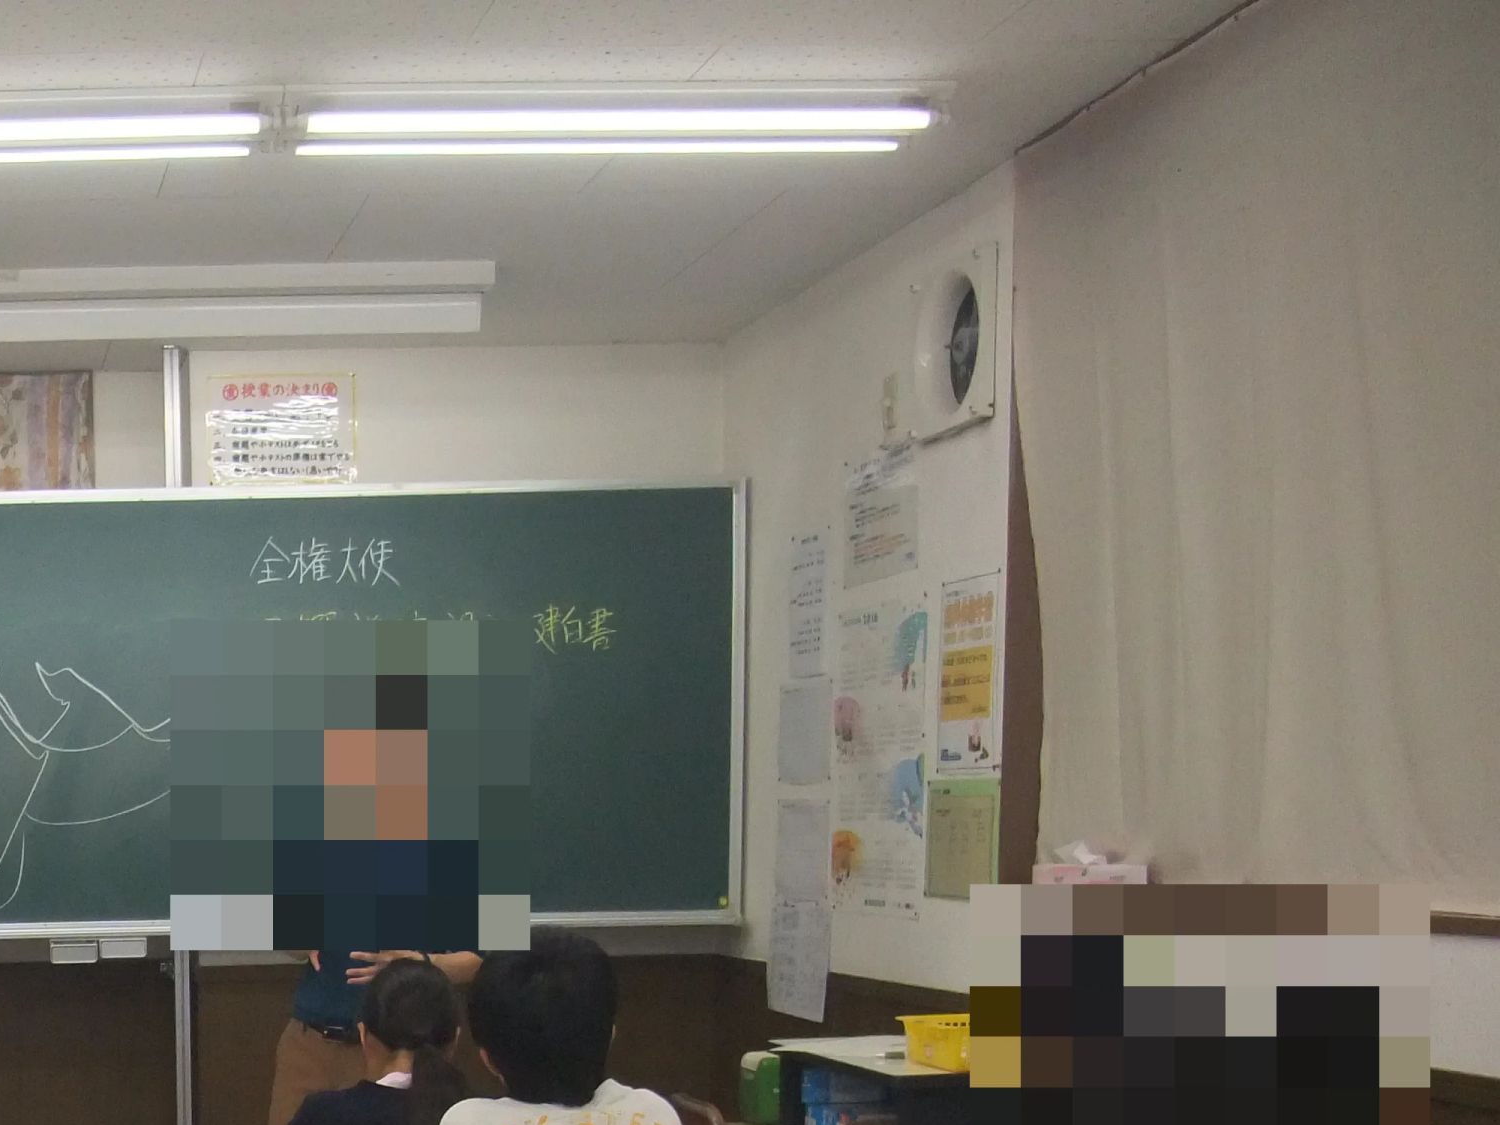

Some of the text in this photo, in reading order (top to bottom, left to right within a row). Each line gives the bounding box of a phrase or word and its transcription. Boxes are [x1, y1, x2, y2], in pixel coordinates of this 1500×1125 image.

[250, 536, 400, 586] 全権大使
[533, 604, 618, 655] 建白書
